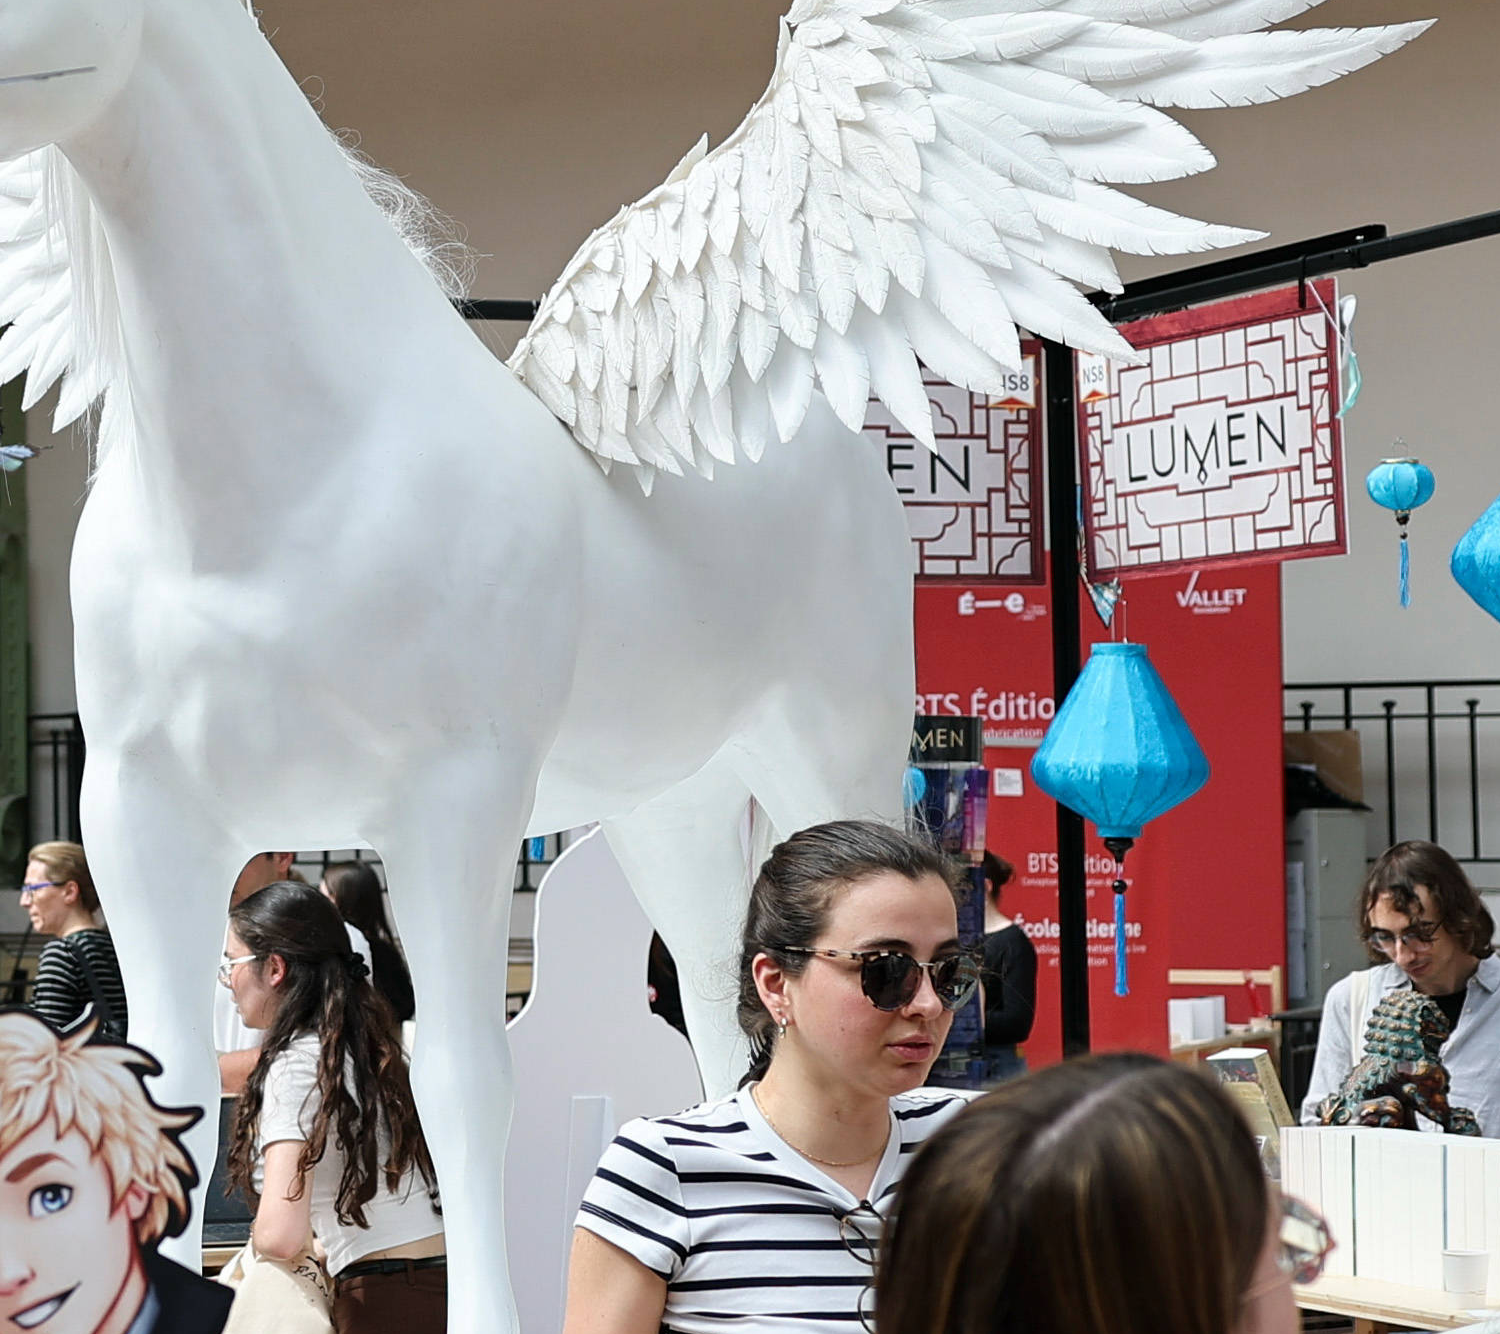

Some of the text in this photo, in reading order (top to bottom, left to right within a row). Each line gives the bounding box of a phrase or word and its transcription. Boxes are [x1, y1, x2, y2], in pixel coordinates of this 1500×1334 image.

[1083, 365, 1104, 385] NS8
[1127, 406, 1286, 485] LUMEN
[1176, 570, 1247, 609] VALLET
[971, 687, 1056, 721] Éditio
[912, 729, 964, 752] MEN
